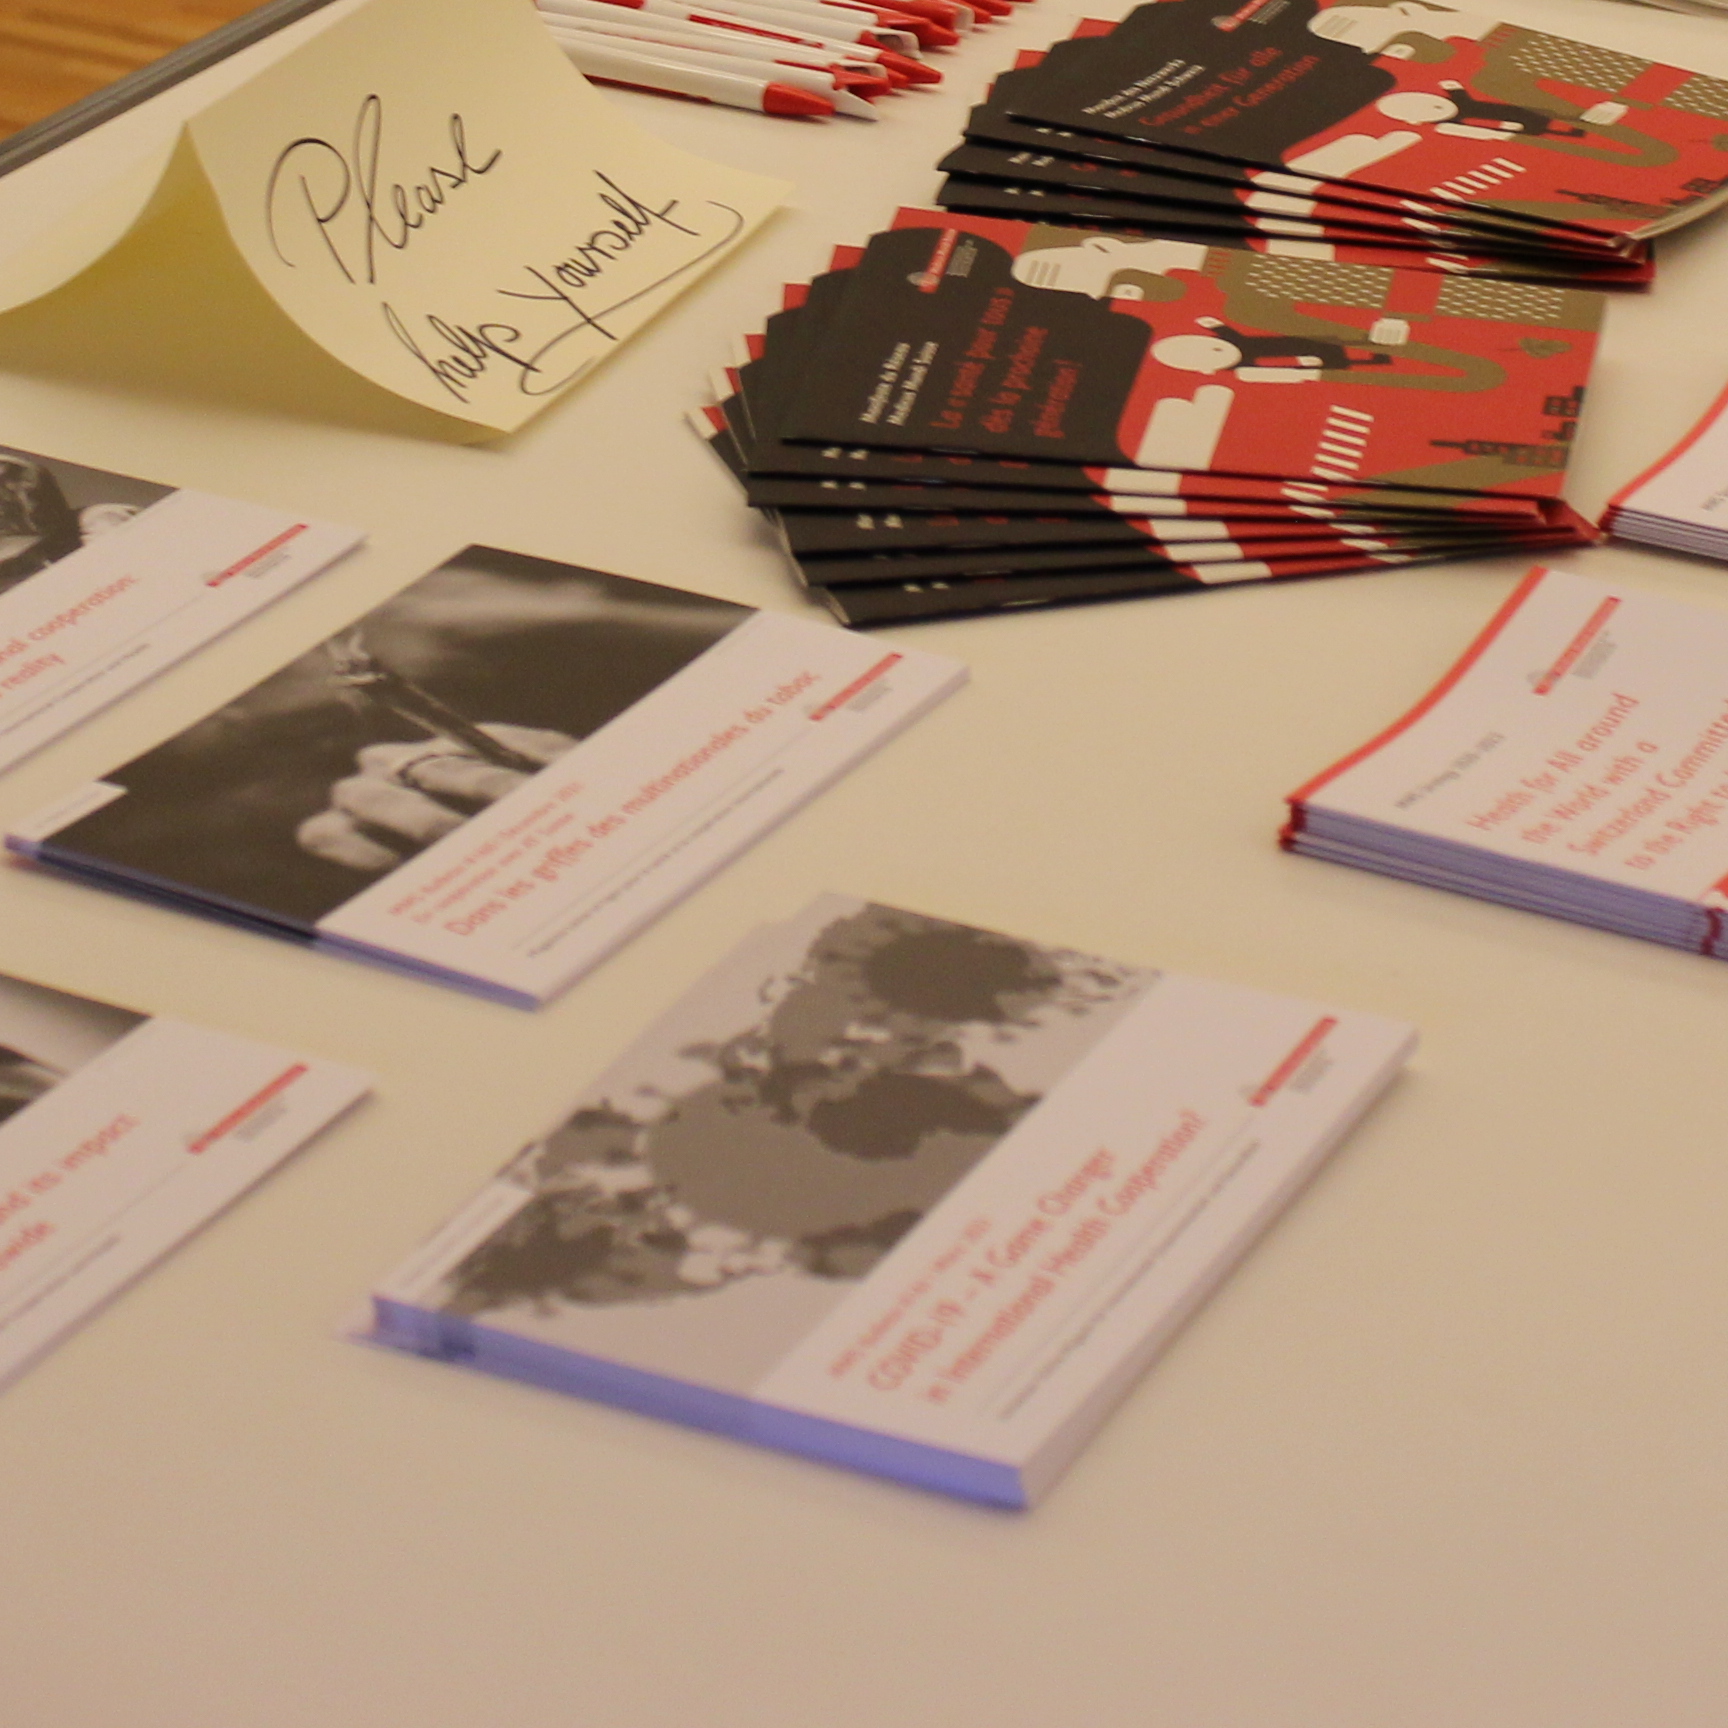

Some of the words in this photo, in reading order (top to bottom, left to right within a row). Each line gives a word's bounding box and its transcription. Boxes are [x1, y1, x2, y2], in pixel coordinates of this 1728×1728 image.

[266, 93, 503, 285] Please
[382, 301, 541, 403] help
[1546, 750, 1584, 773] All
[1575, 691, 1640, 752] around
[1605, 756, 1644, 785] with
[1635, 740, 1660, 754] a
